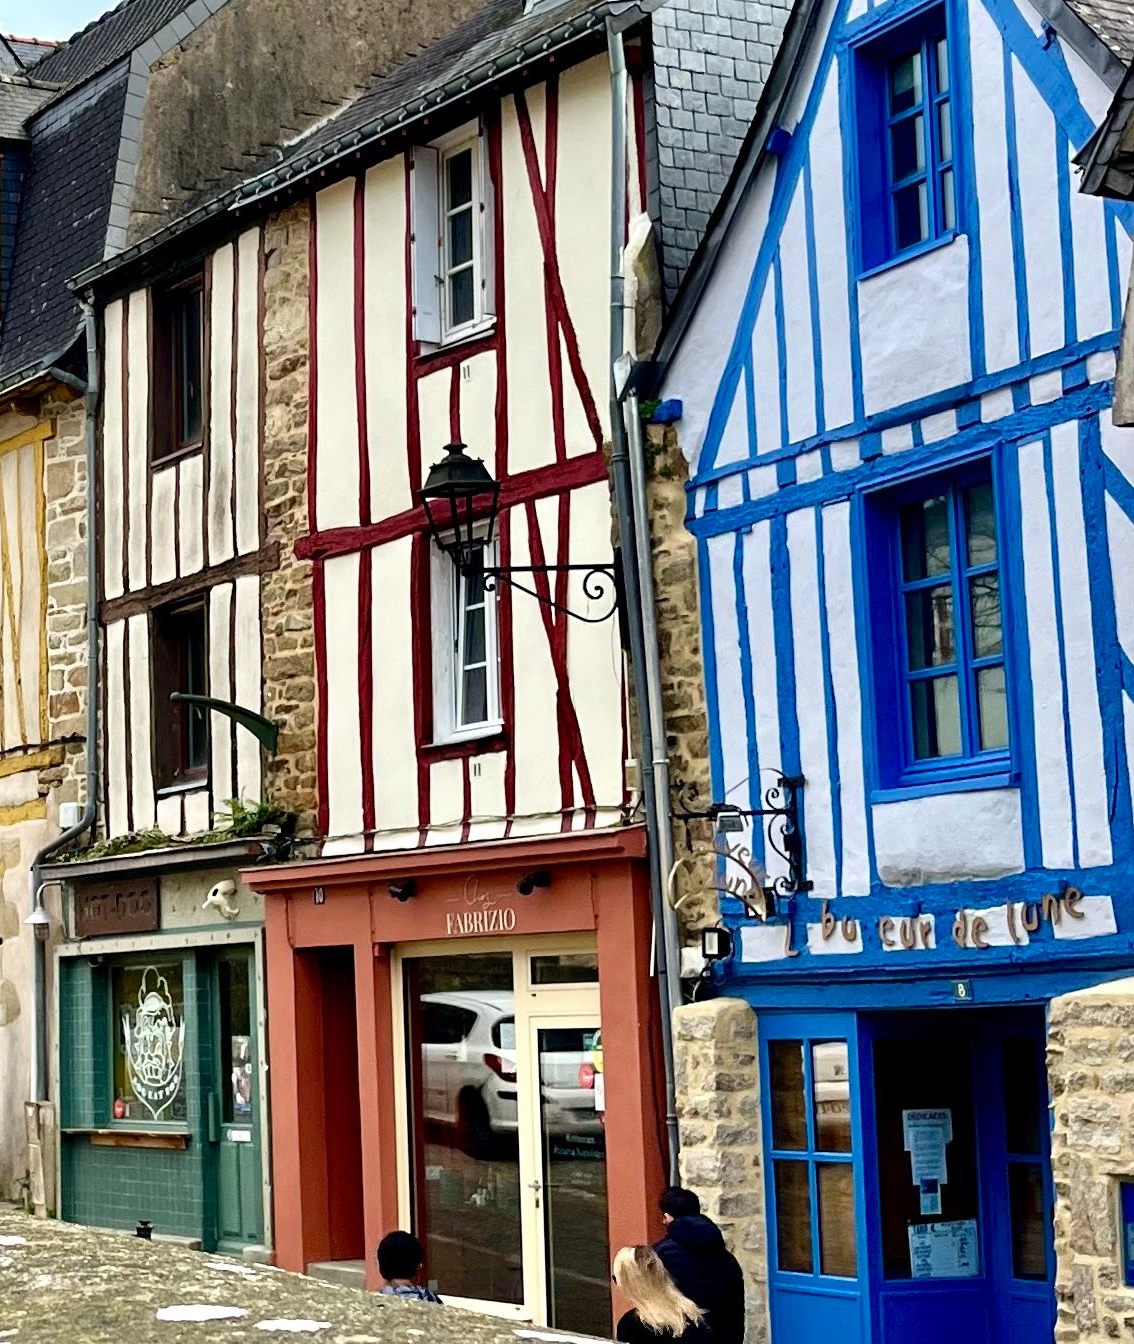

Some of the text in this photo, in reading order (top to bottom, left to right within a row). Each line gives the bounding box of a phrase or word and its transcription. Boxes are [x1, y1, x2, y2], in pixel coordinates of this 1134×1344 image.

[446, 908, 516, 935] FABRIZIO
[952, 906, 988, 949] de
[1006, 886, 1085, 942] lune
[956, 983, 966, 997] 8
